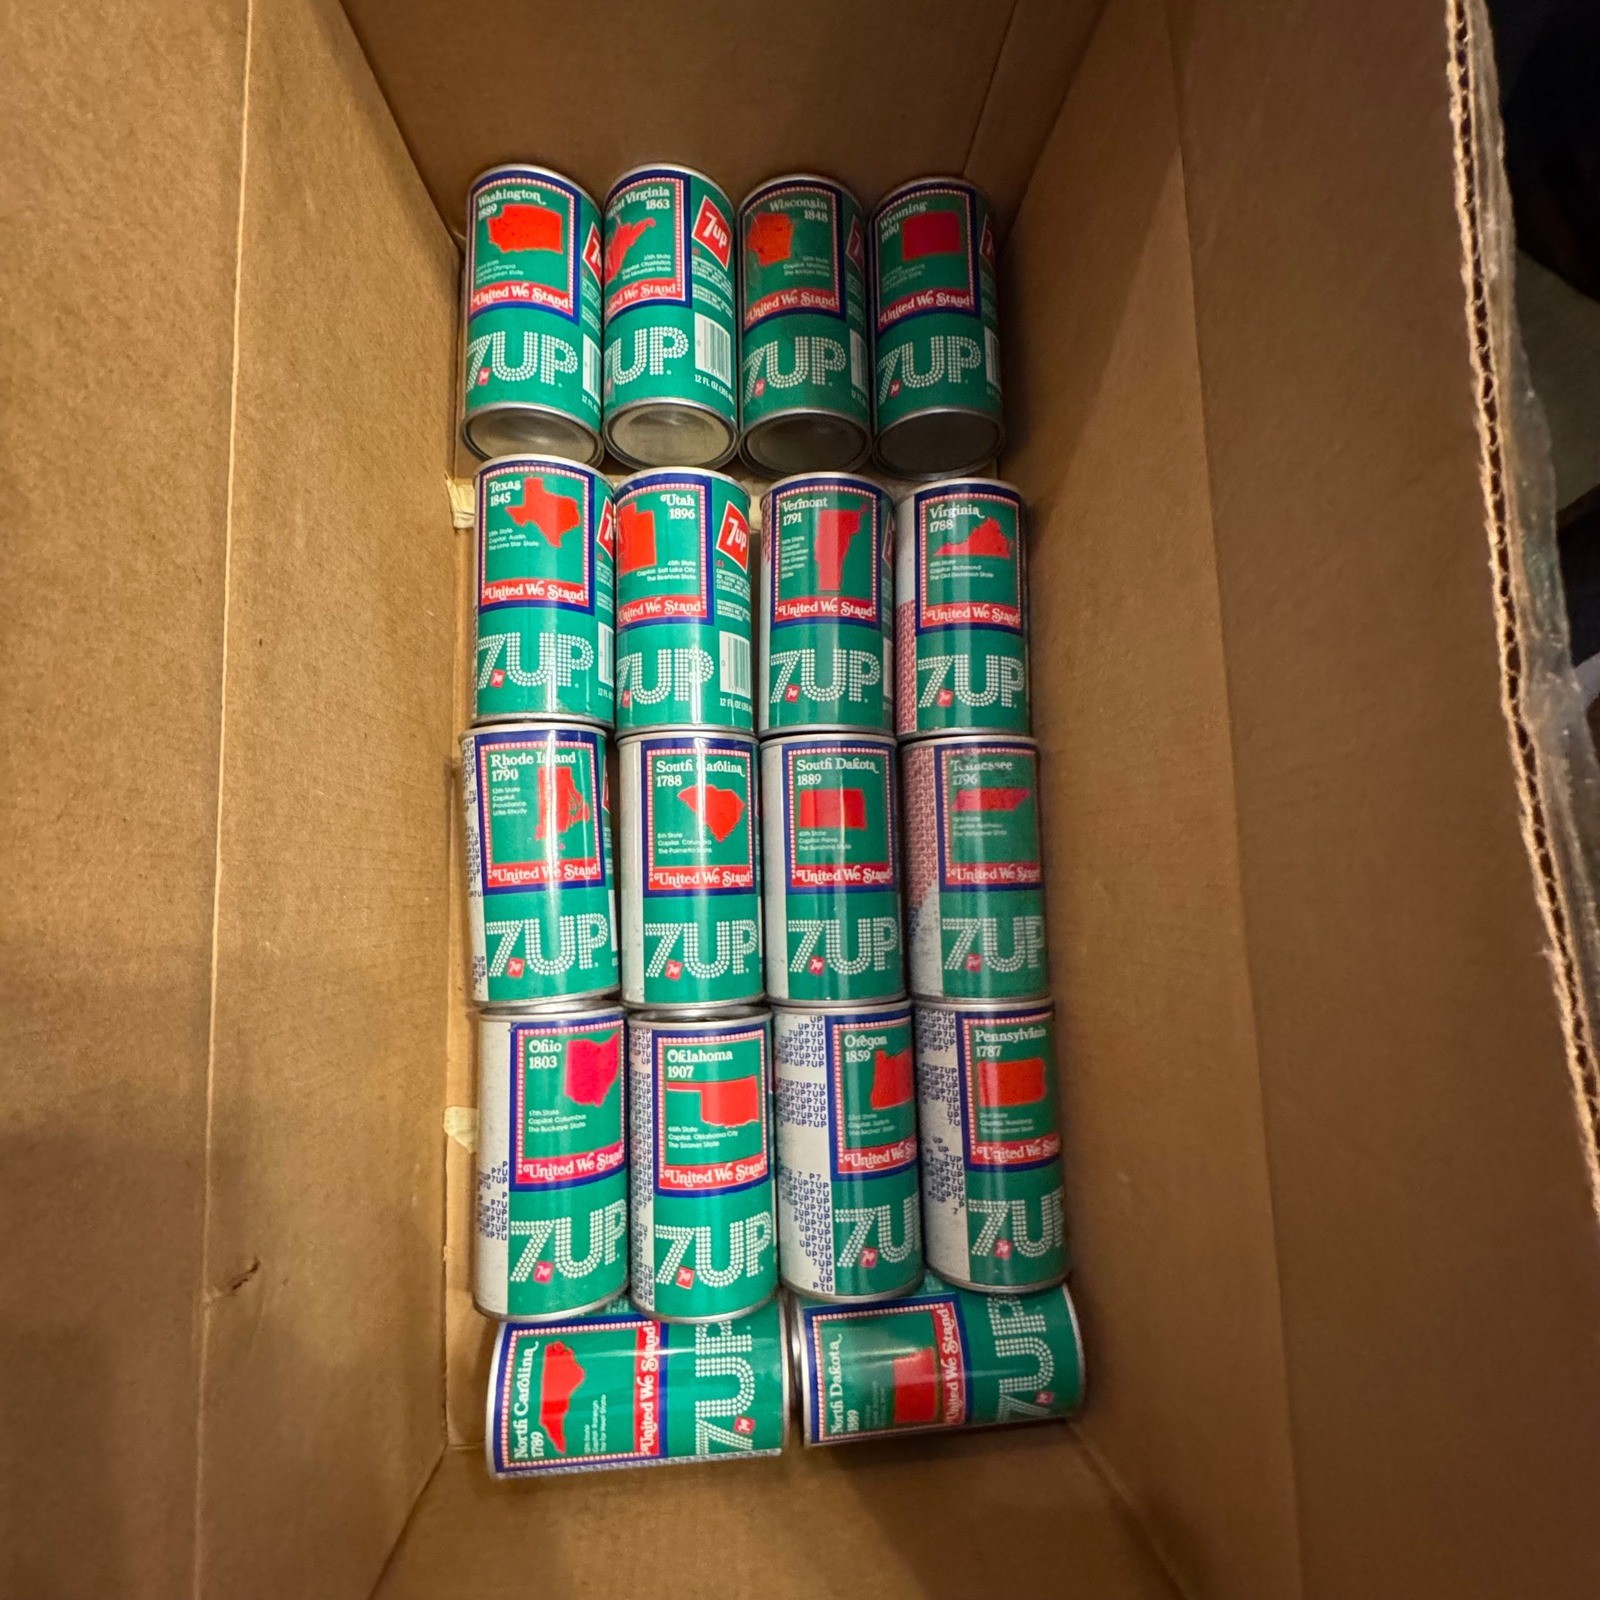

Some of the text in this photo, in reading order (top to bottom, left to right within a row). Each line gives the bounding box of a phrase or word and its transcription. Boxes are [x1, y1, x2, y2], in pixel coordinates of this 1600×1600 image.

[478, 189, 547, 208] Washington
[625, 186, 670, 205] Virginia
[646, 199, 670, 211] 1863
[769, 198, 828, 212] Wisconsin
[804, 209, 828, 222] 1848
[880, 201, 928, 230] Wyoming
[473, 282, 570, 309] United We Stand
[624, 283, 639, 299] We
[640, 284, 676, 299] Stand
[746, 296, 779, 320] United
[781, 289, 798, 304] We
[800, 292, 836, 308] Stand
[880, 290, 970, 322] United We Stand
[464, 330, 579, 394] 7UP
[743, 336, 846, 406] 7UP
[876, 335, 981, 406] 7UP
[694, 374, 701, 383] 12
[489, 480, 521, 494] Texas
[490, 492, 511, 507] 1845
[660, 493, 695, 506] Utah
[782, 497, 828, 513] Vermont
[669, 508, 695, 519] 1896
[783, 512, 802, 526] 1791
[930, 504, 985, 520] Virginia
[726, 517, 747, 552] 7up
[930, 519, 954, 533] 1788
[484, 580, 584, 603] United We Stand
[645, 597, 661, 613] We
[664, 600, 701, 614] Stand
[779, 597, 873, 619] United We Stand
[927, 607, 971, 622] United
[972, 604, 990, 618] We
[478, 632, 594, 690] 7UP
[617, 649, 714, 704] 7UP
[770, 649, 881, 703] 7UP
[918, 654, 1025, 708] 7UP
[720, 697, 727, 706] 12
[490, 753, 534, 769] Rhode
[656, 759, 693, 773] South
[797, 758, 879, 774] South Dakota
[492, 769, 519, 782] 1790
[656, 775, 682, 787] 1788
[797, 774, 822, 786] 1889
[953, 774, 978, 786] 1796
[492, 867, 539, 883] United
[564, 863, 597, 880] Stand
[654, 868, 750, 888] United We Stand
[796, 869, 841, 884] United
[841, 865, 861, 880] We
[950, 868, 997, 884] United
[1000, 864, 1015, 879] We
[485, 913, 609, 977] 7UP
[644, 919, 758, 979] 7UP
[787, 917, 898, 975] 7UP
[942, 915, 1044, 973] 7UP
[529, 1039, 562, 1054] Ohio
[844, 1034, 887, 1049] Oregon
[976, 1045, 1002, 1057] 1787
[529, 1056, 557, 1070] 1803
[667, 1049, 733, 1063] Oklahoma
[845, 1050, 871, 1062] 1859
[667, 1066, 694, 1078] 1907
[844, 1153, 890, 1169] United
[977, 1146, 1025, 1163] United
[523, 1162, 574, 1181] United
[576, 1152, 595, 1170] We
[665, 1159, 765, 1187] United We Stand
[834, 1192, 919, 1268] 7U
[510, 1199, 627, 1283] 7UP
[655, 1211, 772, 1288] 7UP
[936, 1309, 965, 1423] United We Stand
[987, 1294, 1055, 1423] 7UP
[637, 1326, 660, 1453] United We Stand
[695, 1320, 755, 1455] 7UP
[828, 1334, 844, 1434] North Dakota
[513, 1341, 539, 1459] North Carolina
[847, 1410, 859, 1431] 1889
[530, 1432, 544, 1458] 1789
